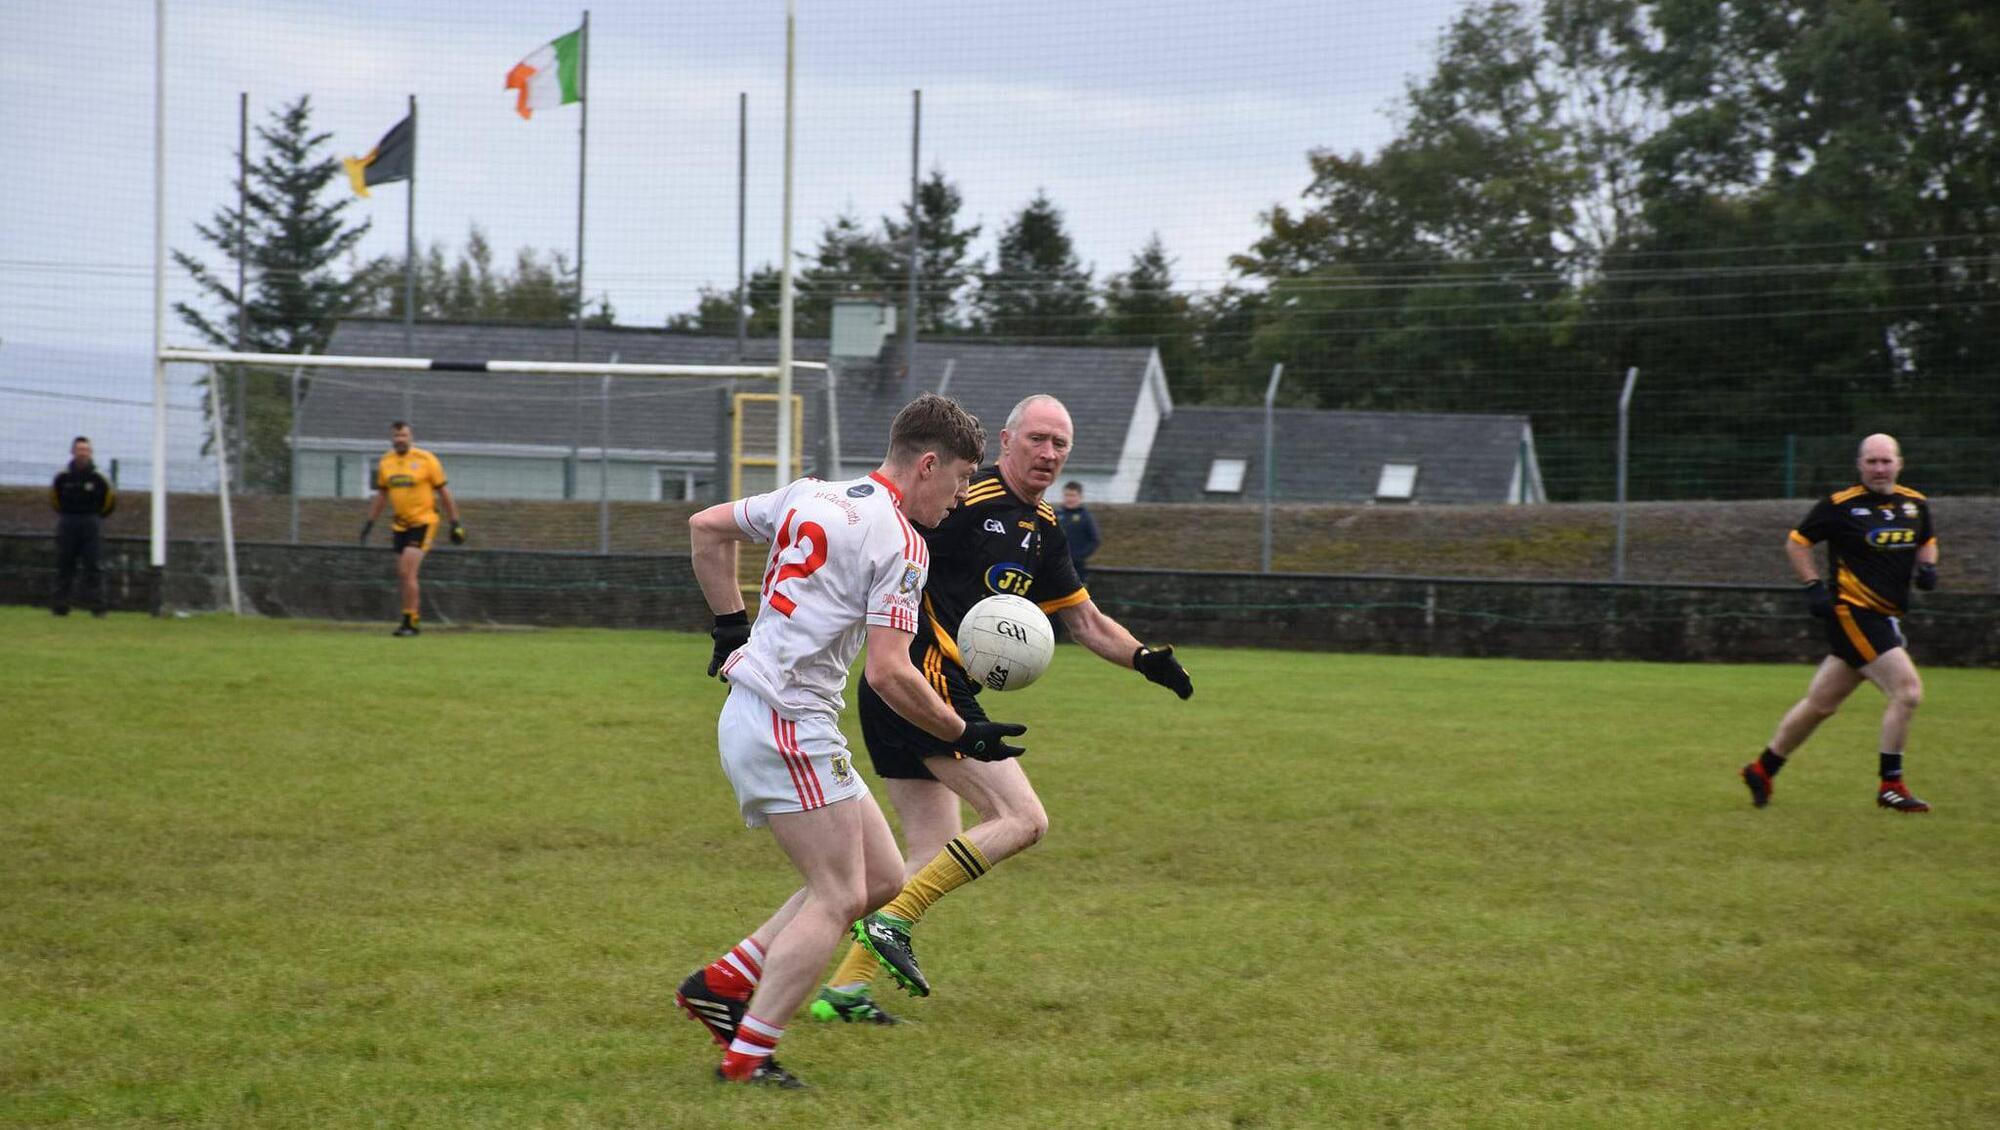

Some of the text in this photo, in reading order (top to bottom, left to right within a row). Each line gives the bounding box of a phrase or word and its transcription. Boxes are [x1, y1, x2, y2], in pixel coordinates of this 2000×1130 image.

[1020, 531, 1032, 551] 4
[1875, 530, 1916, 544] JFS
[762, 508, 828, 619] 12
